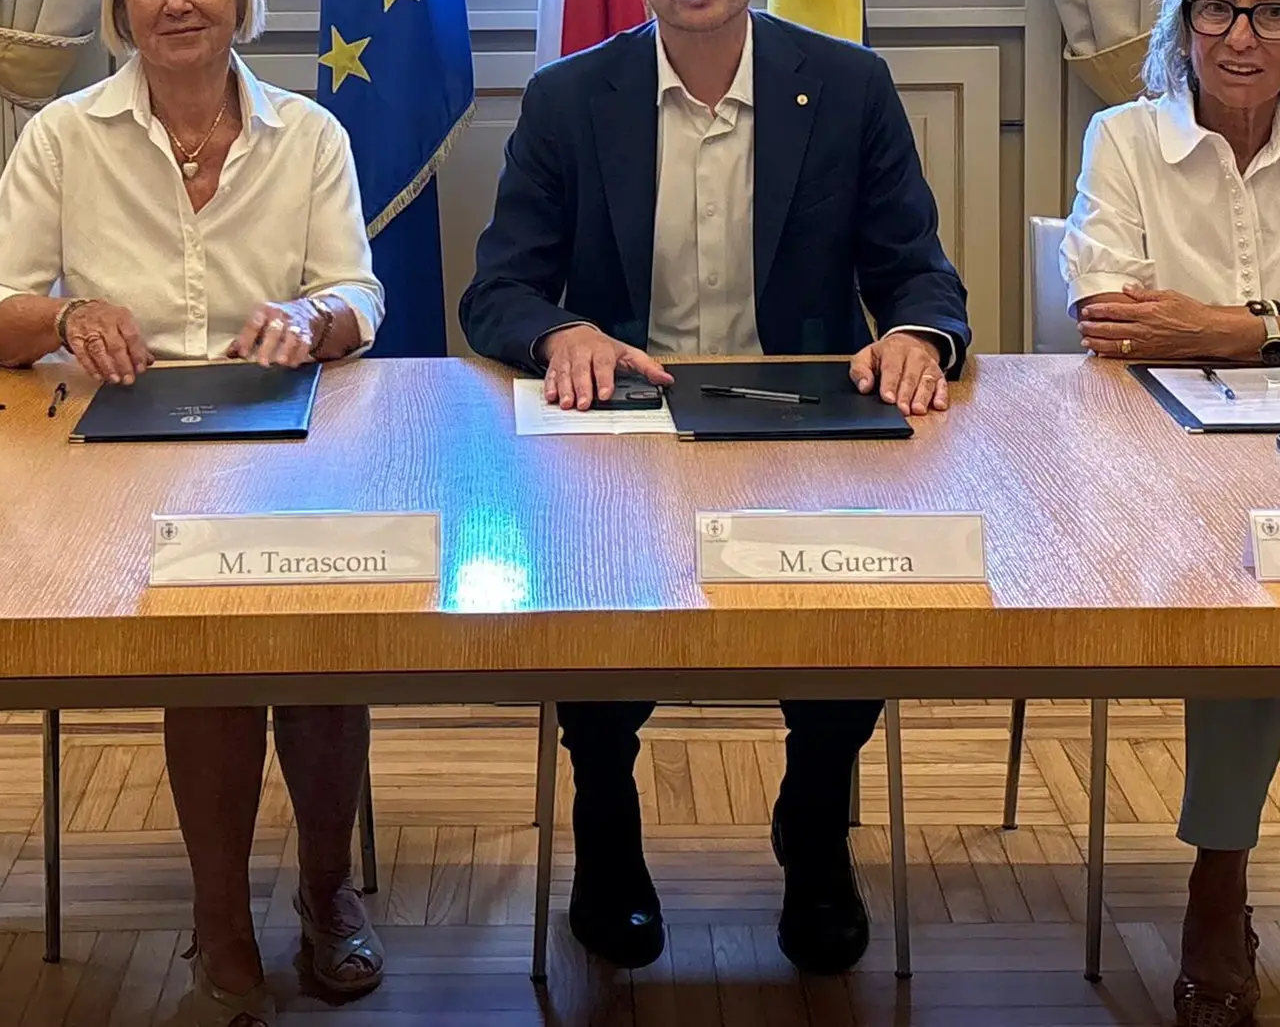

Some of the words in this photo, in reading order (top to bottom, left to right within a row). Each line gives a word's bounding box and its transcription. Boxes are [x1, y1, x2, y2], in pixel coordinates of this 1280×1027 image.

[218, 551, 251, 575] M.
[260, 549, 387, 574] Tarasconi
[778, 550, 813, 574] M.
[820, 549, 914, 574] Guerra
